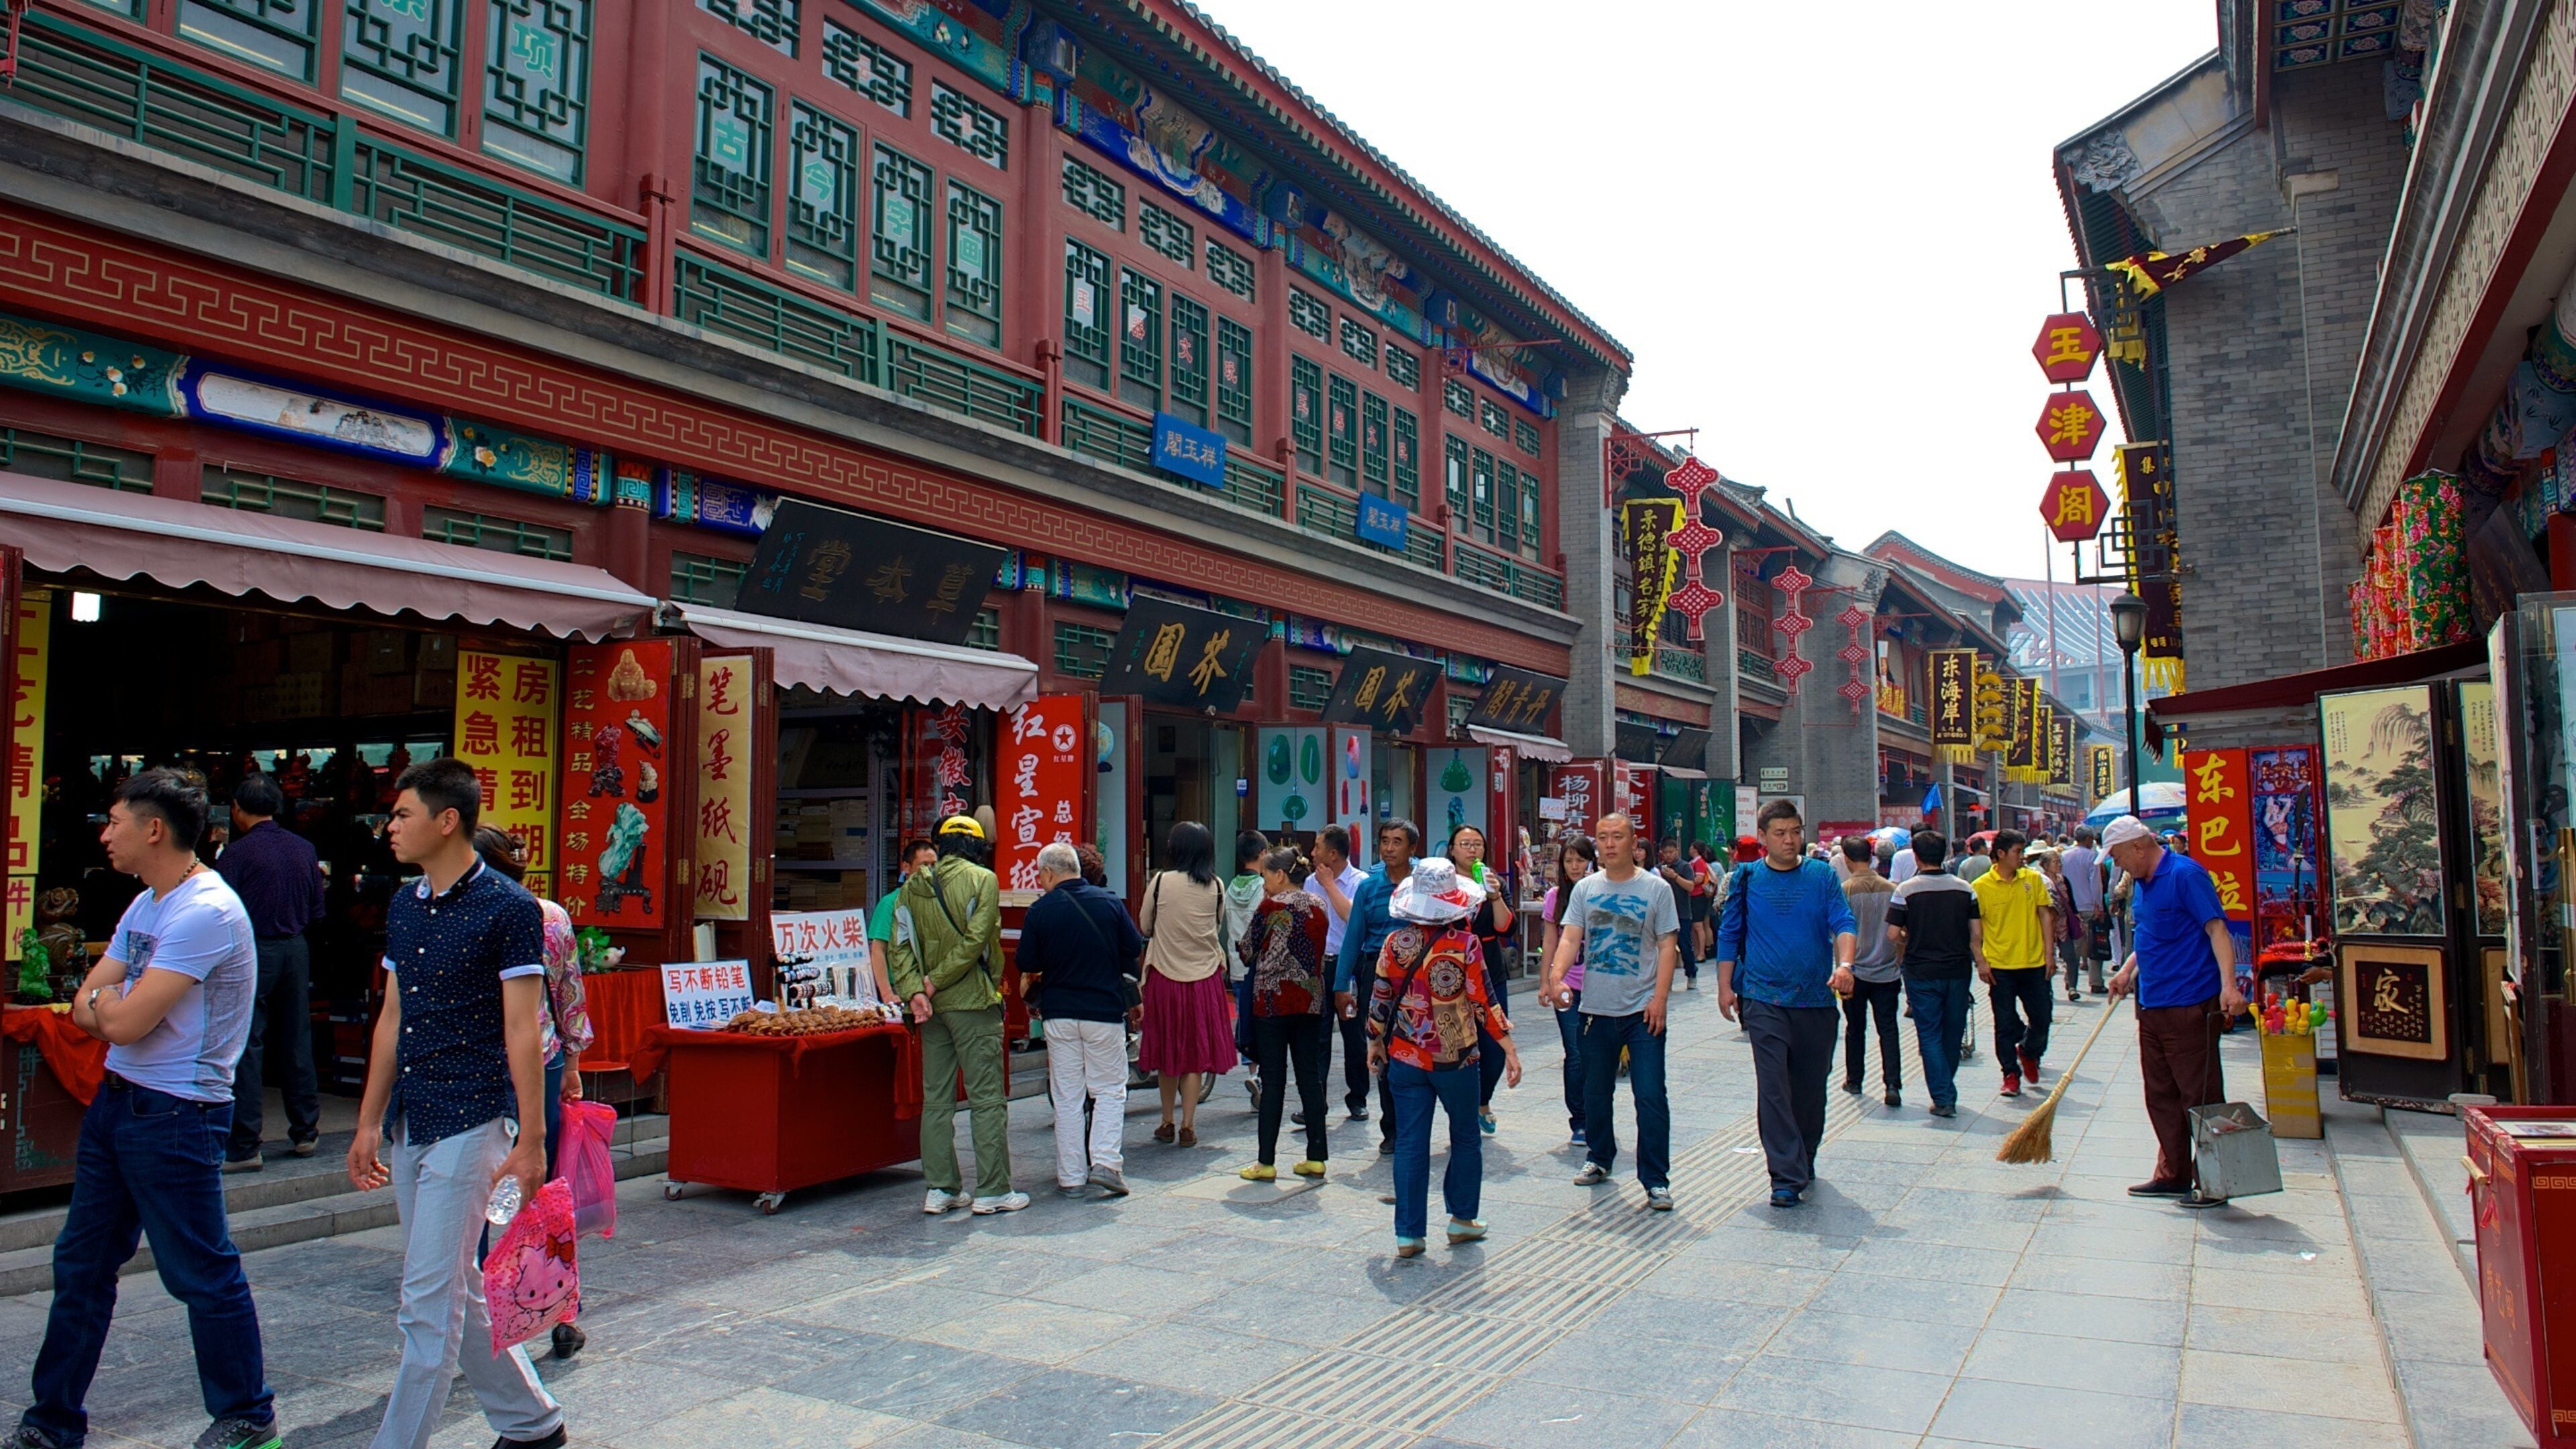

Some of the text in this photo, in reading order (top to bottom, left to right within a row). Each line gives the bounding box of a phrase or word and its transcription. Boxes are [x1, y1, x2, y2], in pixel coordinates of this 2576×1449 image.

[2047, 327, 2094, 527] 玉津阁
[696, 666, 739, 906] 笔墨纸砚
[667, 965, 746, 994] 写不断铅笔
[776, 915, 865, 954] 万次火柴
